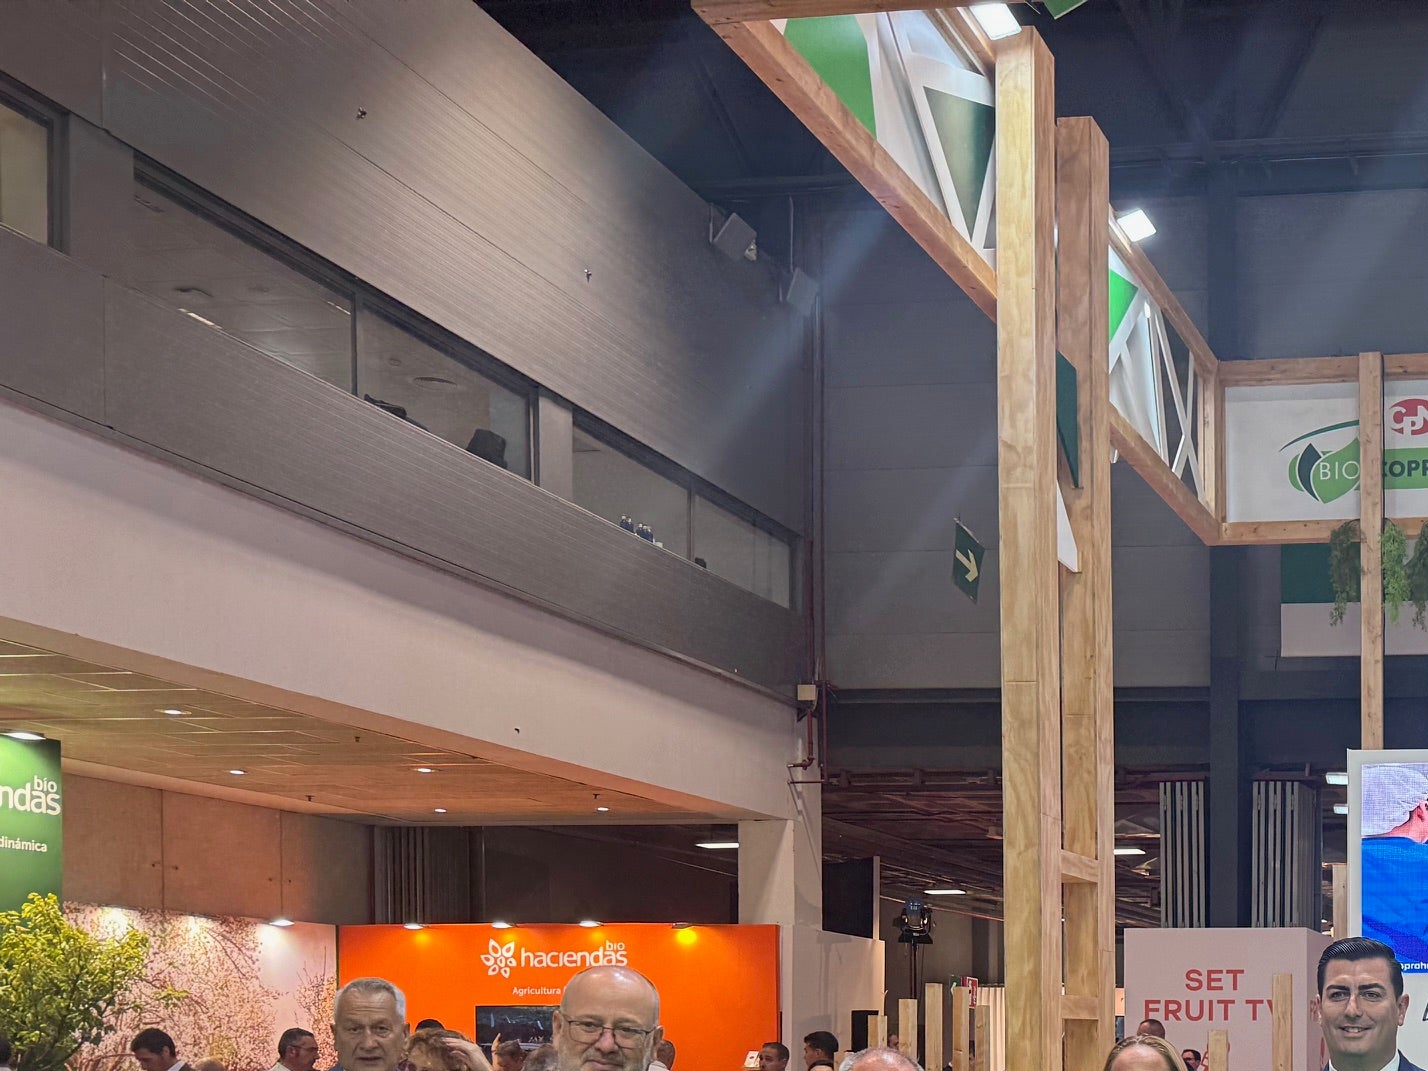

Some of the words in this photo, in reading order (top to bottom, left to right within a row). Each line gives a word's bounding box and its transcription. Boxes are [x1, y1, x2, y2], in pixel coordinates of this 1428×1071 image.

[1319, 461, 1360, 480] BIO
[0, 783, 61, 816] ndas
[520, 948, 628, 968] haciendas
[1185, 969, 1245, 991] SET
[512, 986, 561, 997] Agricultura
[1144, 999, 1235, 1021] FRUIT
